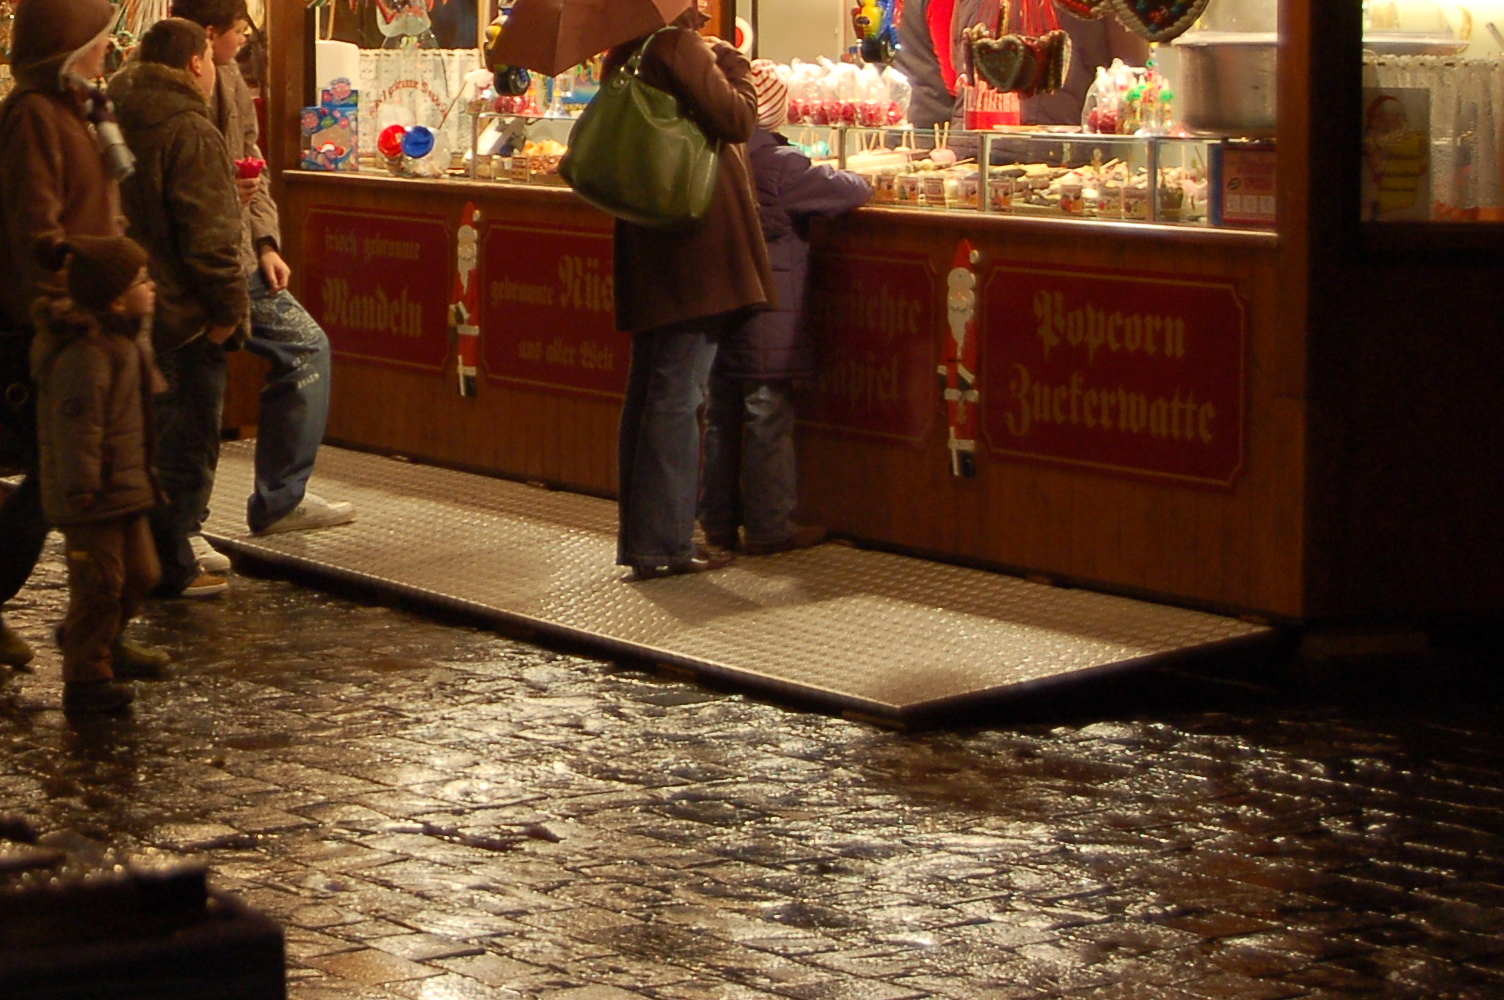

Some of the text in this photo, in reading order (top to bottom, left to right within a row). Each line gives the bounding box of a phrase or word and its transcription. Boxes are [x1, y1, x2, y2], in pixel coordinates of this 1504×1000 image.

[321, 276, 423, 340] Mandeln
[1033, 290, 1186, 362] Popcorn
[1004, 363, 1216, 444] Zuckerwatte
